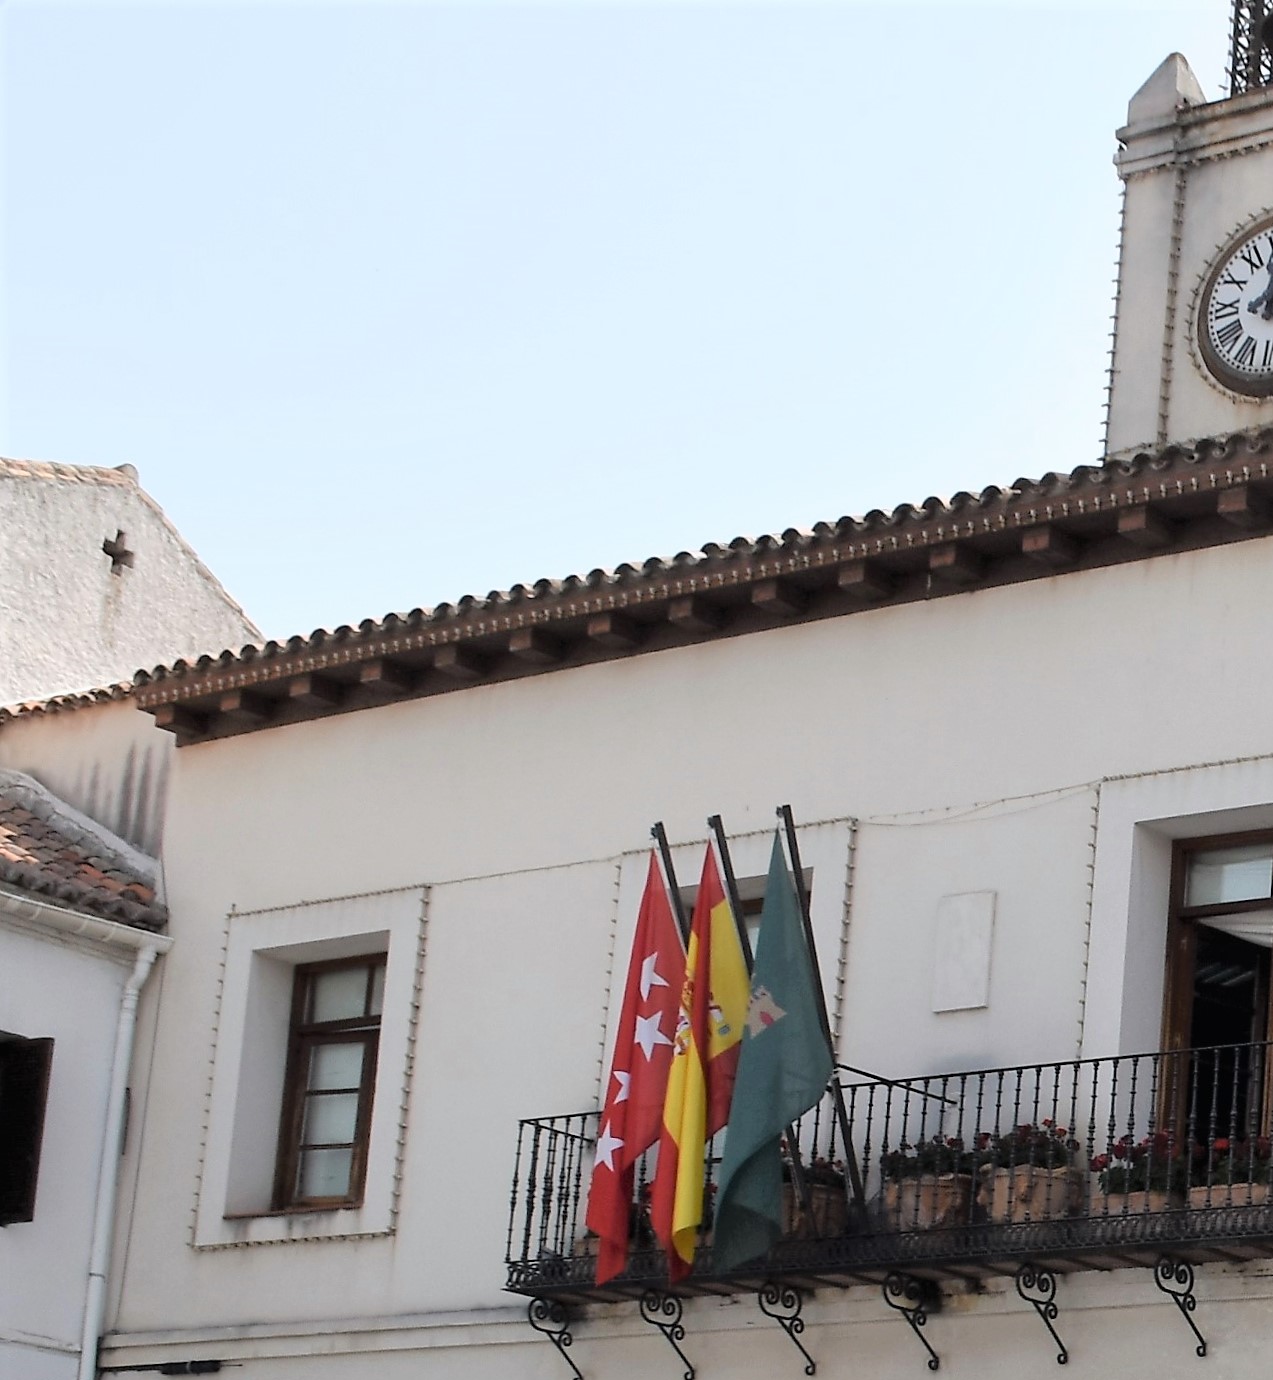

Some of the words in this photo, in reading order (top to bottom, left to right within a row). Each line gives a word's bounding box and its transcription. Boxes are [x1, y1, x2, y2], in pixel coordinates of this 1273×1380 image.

[1241, 244, 1264, 275] XI
[1223, 272, 1248, 292] X
[1214, 299, 1240, 320] IX
[1216, 319, 1244, 353] VIII
[1233, 336, 1257, 366] VII
